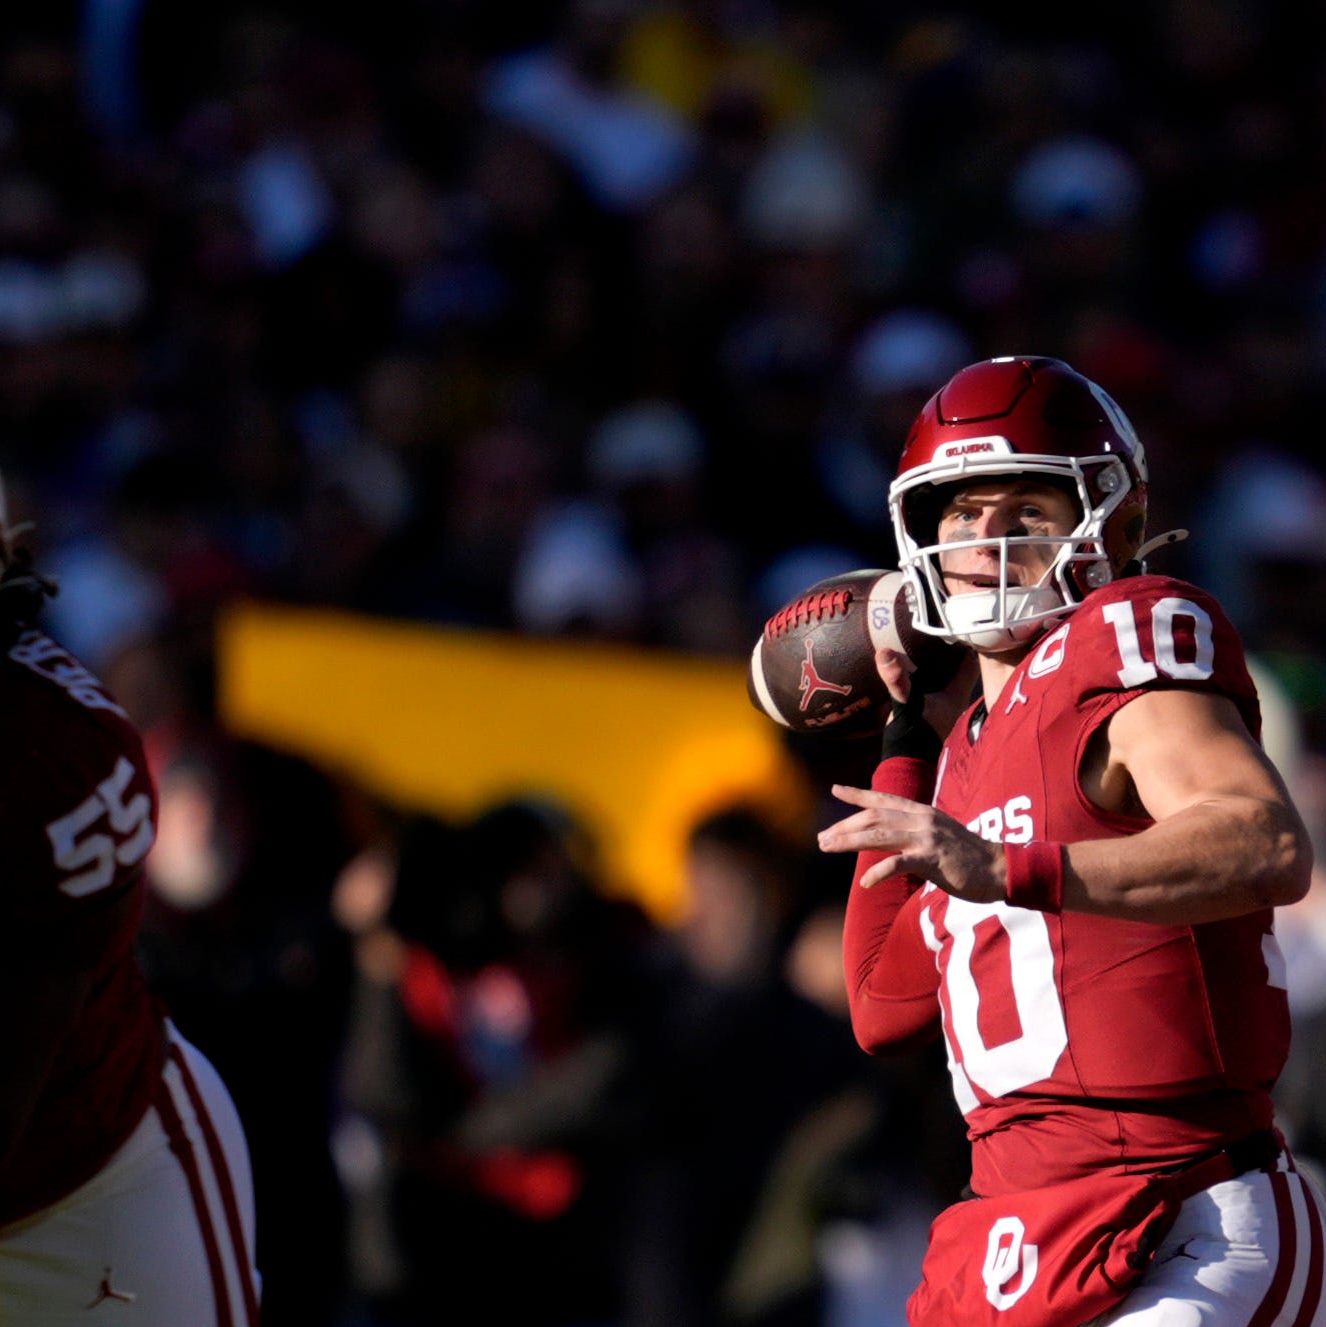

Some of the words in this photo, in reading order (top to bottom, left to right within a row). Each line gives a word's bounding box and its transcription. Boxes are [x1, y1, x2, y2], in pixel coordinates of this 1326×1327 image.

[1101, 597, 1215, 689] 10
[46, 754, 155, 898] 55
[981, 1216, 1039, 1312] OU
